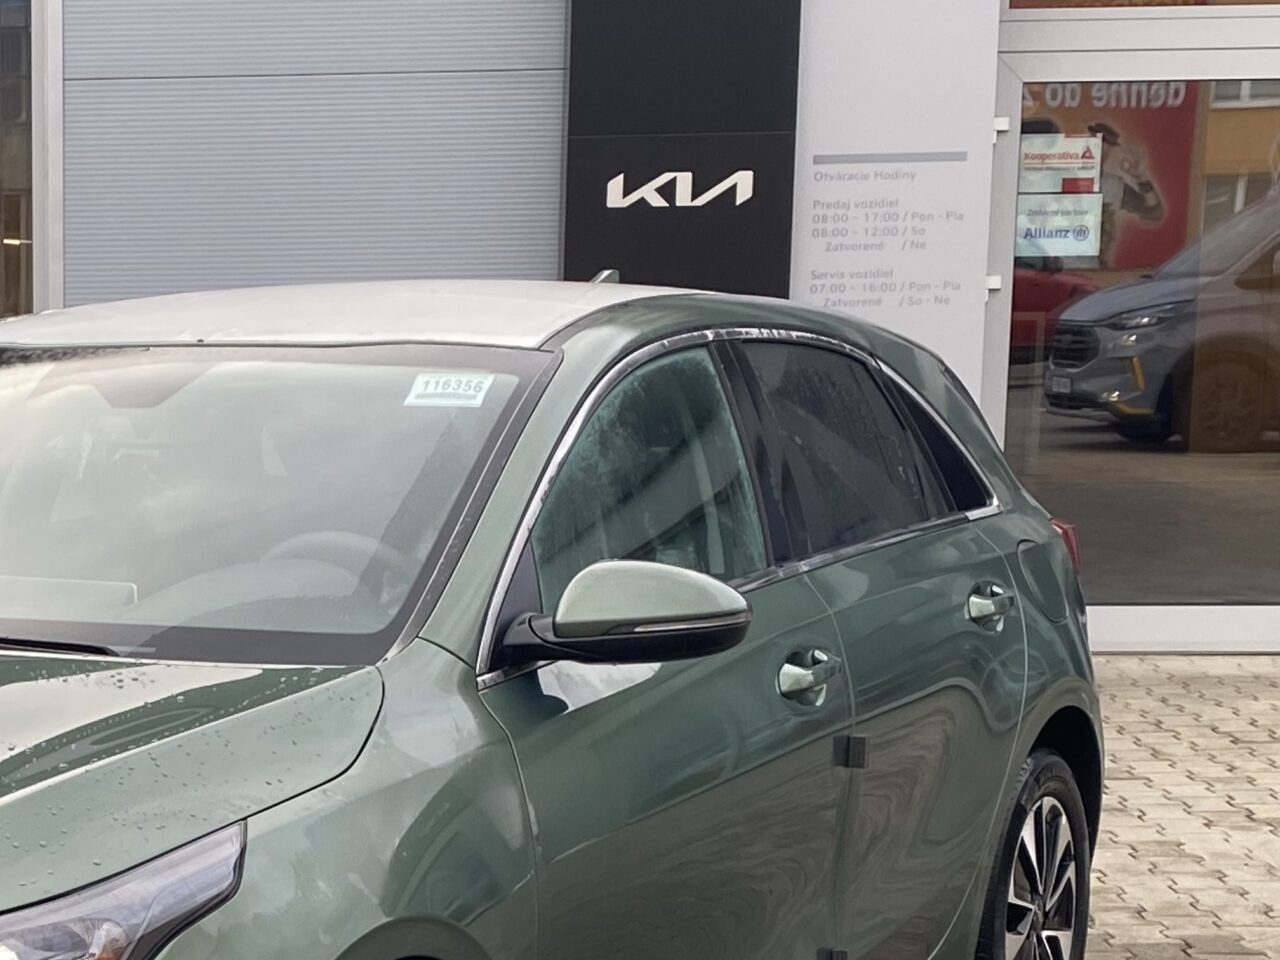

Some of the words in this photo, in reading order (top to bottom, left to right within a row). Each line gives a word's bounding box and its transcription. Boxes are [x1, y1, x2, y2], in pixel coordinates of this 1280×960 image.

[1024, 151, 1080, 163] Kooperativa
[873, 170, 917, 182] Hodiny
[606, 169, 754, 208] KIA
[812, 200, 851, 211] Predaj
[854, 199, 899, 209] vozidiel
[812, 213, 849, 224] 08:00
[864, 212, 900, 223] 17:00
[911, 212, 934, 222] Pon
[946, 211, 965, 221] Pia
[812, 228, 849, 238] 08:00
[864, 226, 899, 237] 12:00
[911, 226, 926, 236] So
[1024, 227, 1071, 239] Allianz
[910, 240, 927, 249] Ne
[810, 270, 846, 280] Servis
[810, 283, 847, 294] 07:00
[862, 282, 897, 293] 16:00
[908, 281, 932, 291] Pon
[907, 296, 922, 306] So
[933, 295, 951, 305] Ne
[422, 378, 485, 394] 116356
